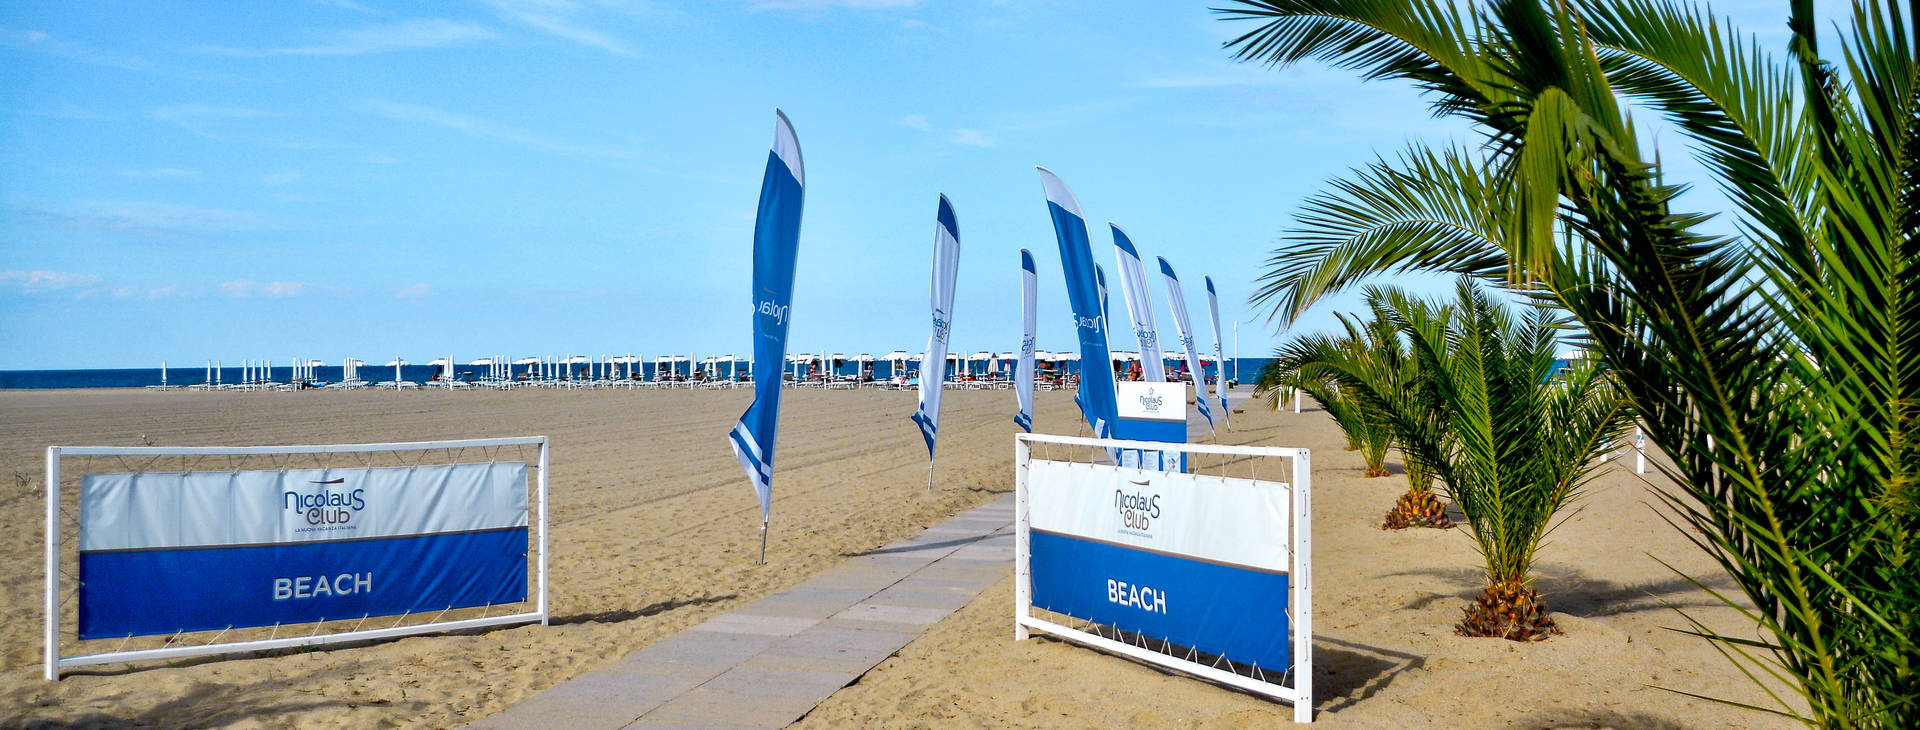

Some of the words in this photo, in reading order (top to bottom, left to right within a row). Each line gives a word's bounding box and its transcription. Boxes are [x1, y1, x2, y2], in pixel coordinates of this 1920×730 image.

[306, 507, 351, 526] Club
[1123, 509, 1150, 531] Club
[274, 571, 372, 600] BEACH
[1107, 578, 1167, 615] BEACH
